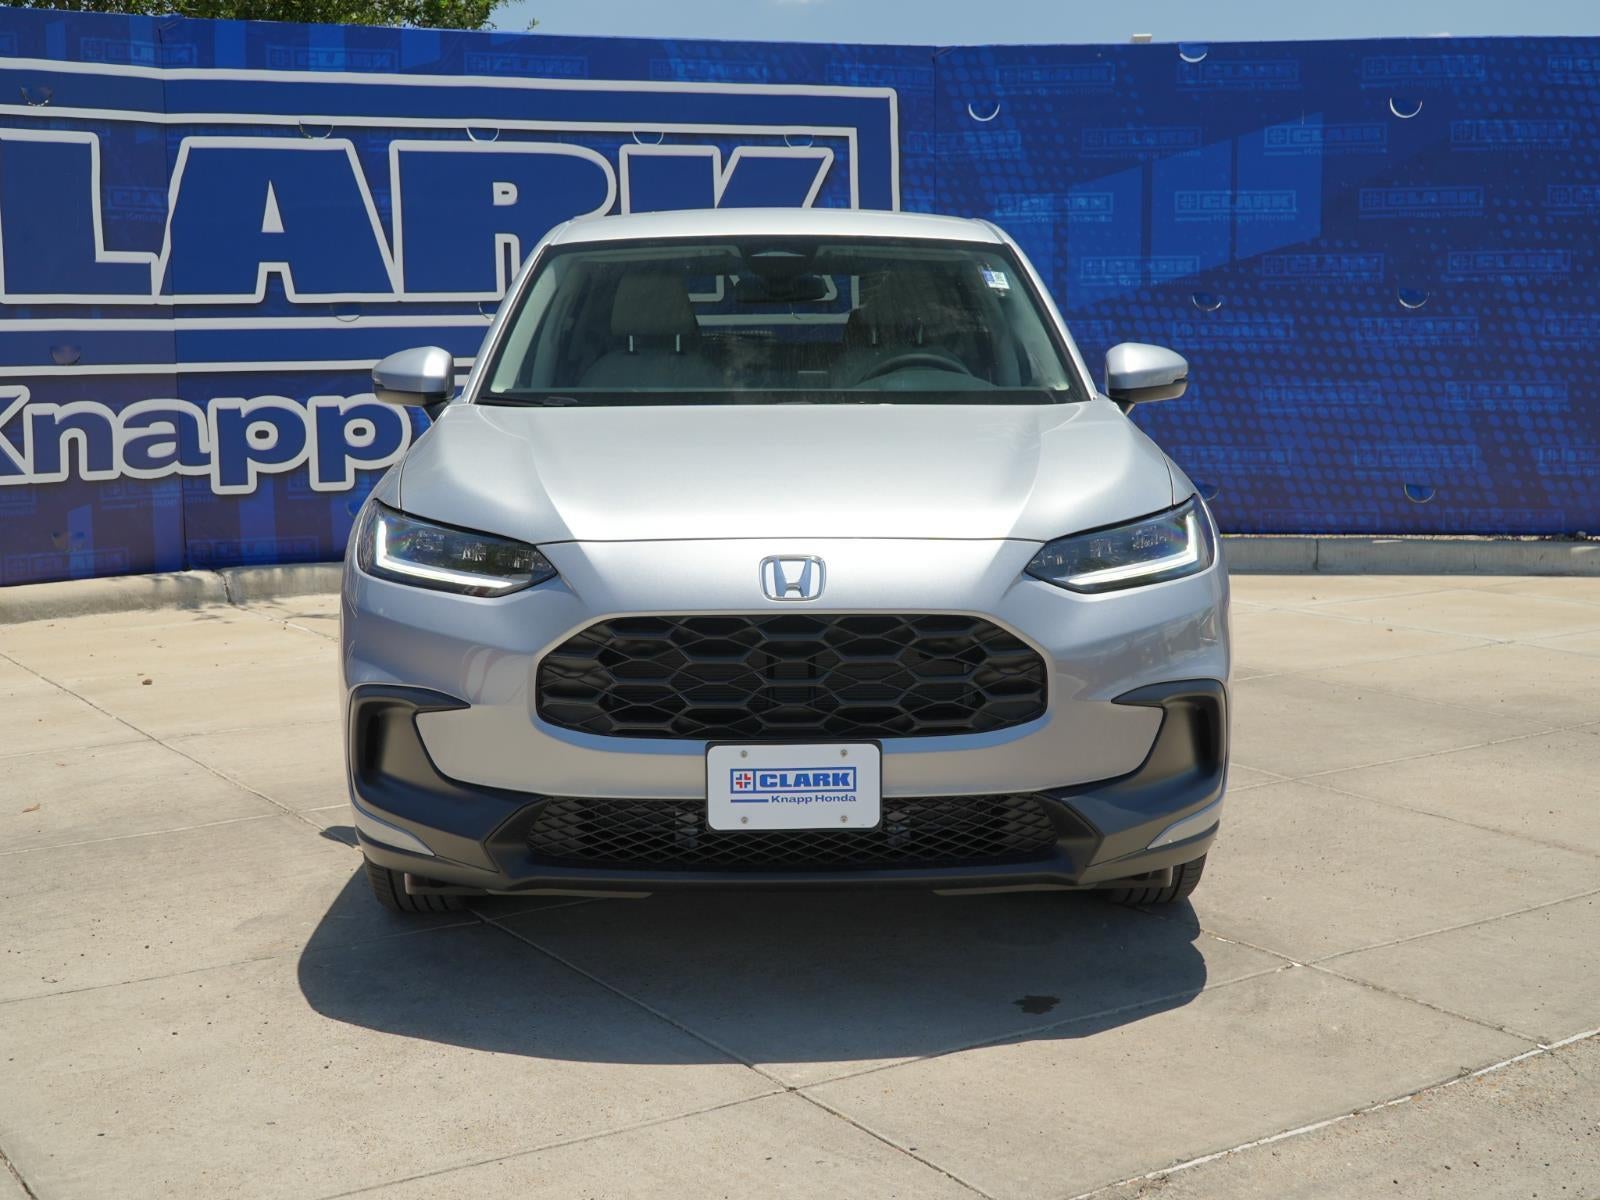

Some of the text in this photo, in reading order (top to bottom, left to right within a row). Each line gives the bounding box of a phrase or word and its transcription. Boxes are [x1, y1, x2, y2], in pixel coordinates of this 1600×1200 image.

[759, 772, 851, 788] CLARK
[771, 794, 857, 804] Knapp Honda
